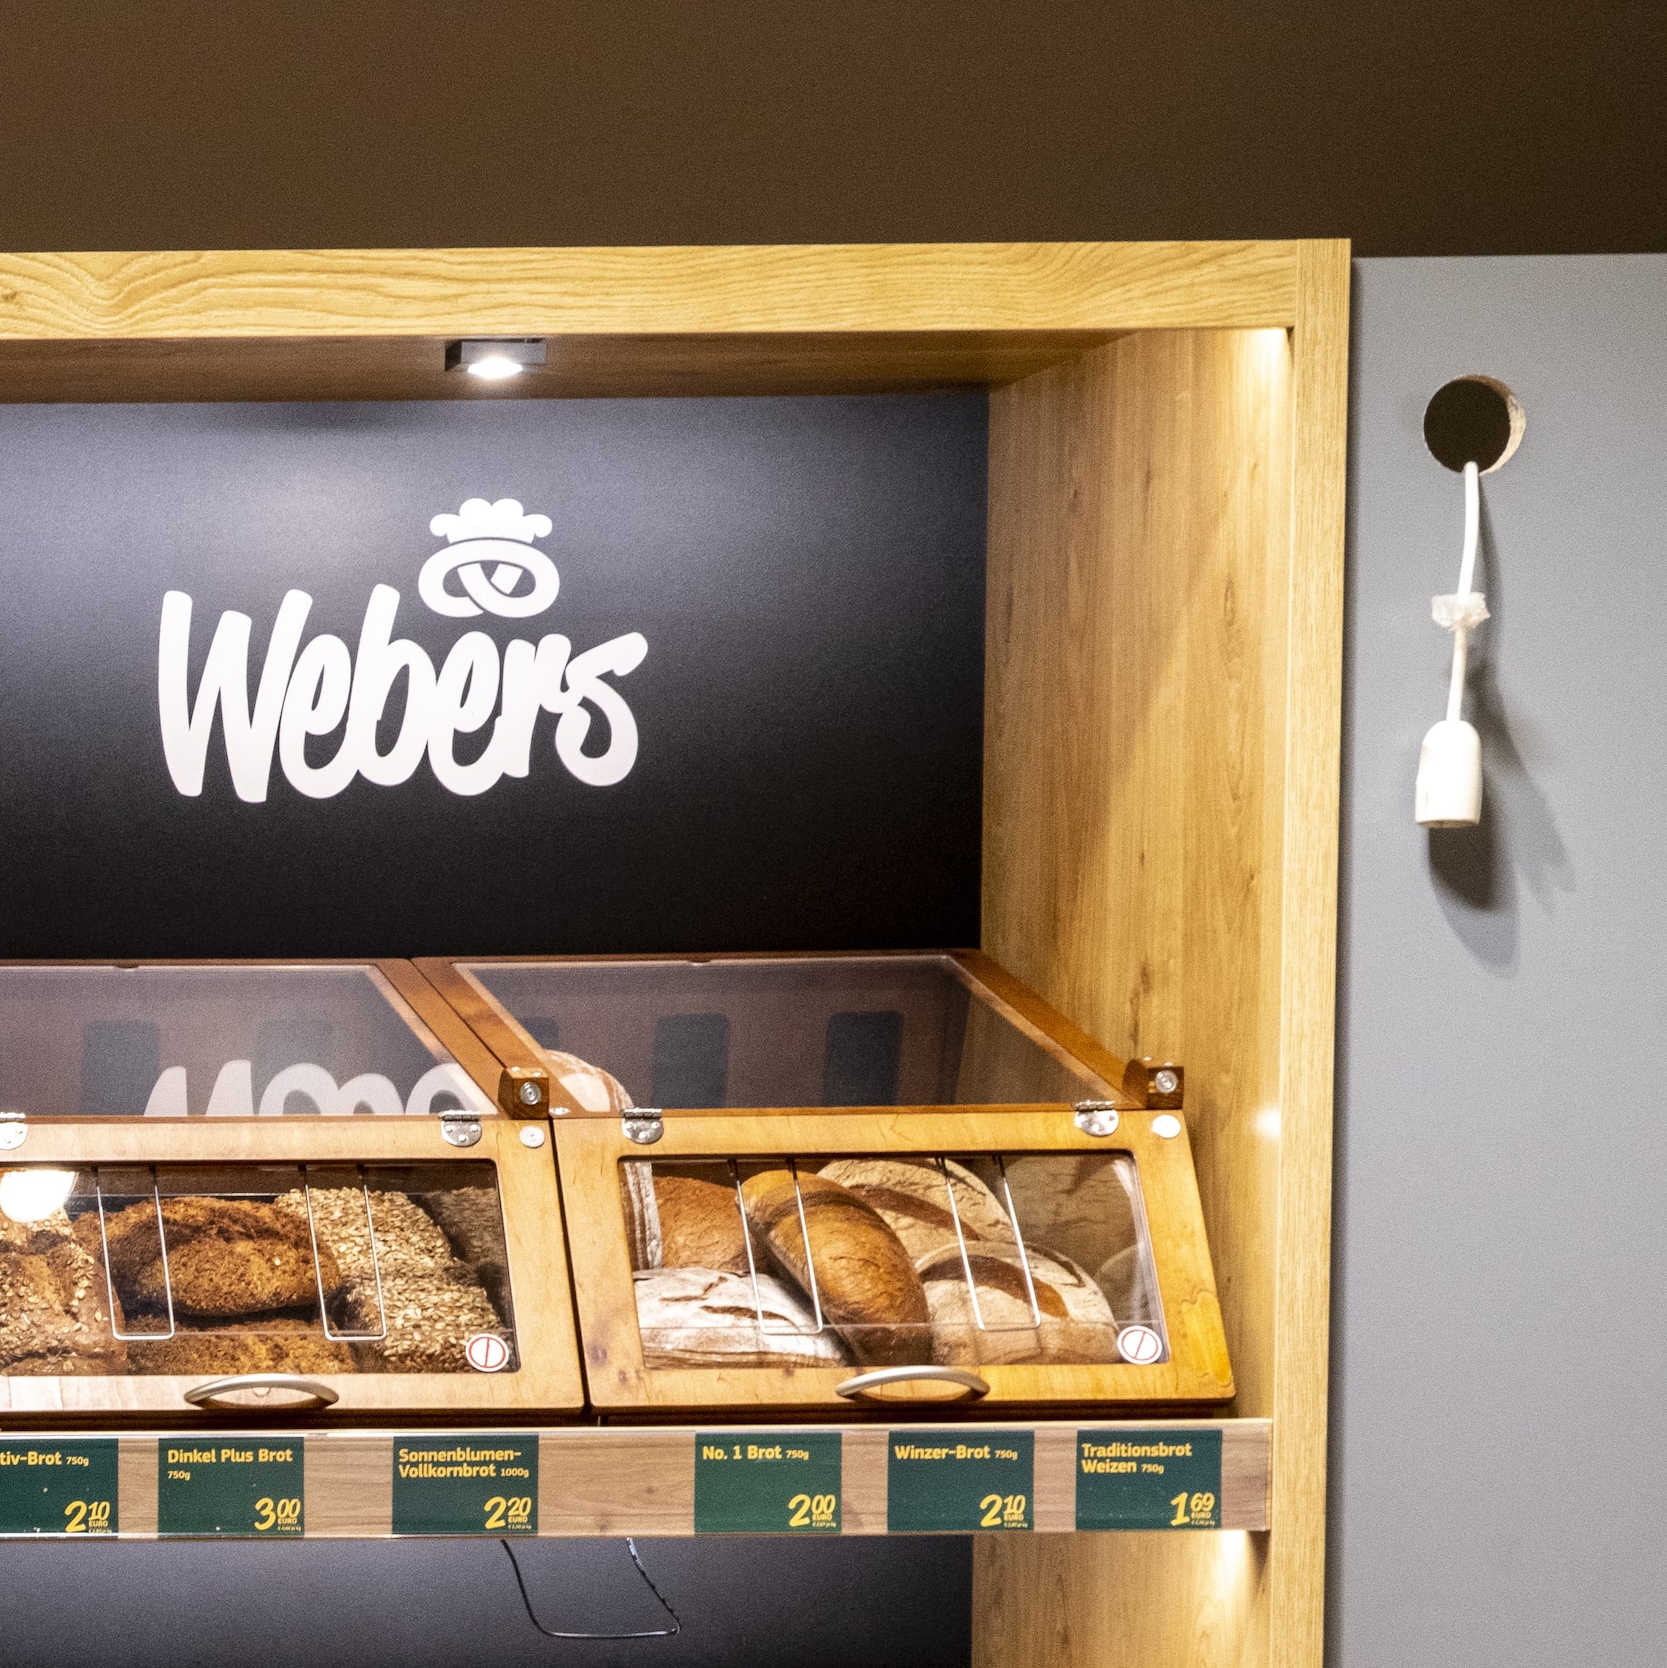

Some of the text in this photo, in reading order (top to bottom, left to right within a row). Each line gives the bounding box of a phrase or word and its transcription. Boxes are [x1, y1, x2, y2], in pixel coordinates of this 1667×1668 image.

[157, 583, 649, 803] Webers
[168, 1449, 292, 1463] Dinkel Plus Brot
[399, 1447, 521, 1462] Sonnenblumen-
[703, 1445, 809, 1460] No. 1 Brot 750g
[895, 1445, 1018, 1460] Winzer-Brot 750g
[1082, 1442, 1192, 1457] Traditionsbrot
[66, 1456, 89, 1466] 750g
[1082, 1459, 1137, 1473] Weizen
[168, 1471, 190, 1480] 750g
[399, 1462, 529, 1478] Vollkornbrot 1000g
